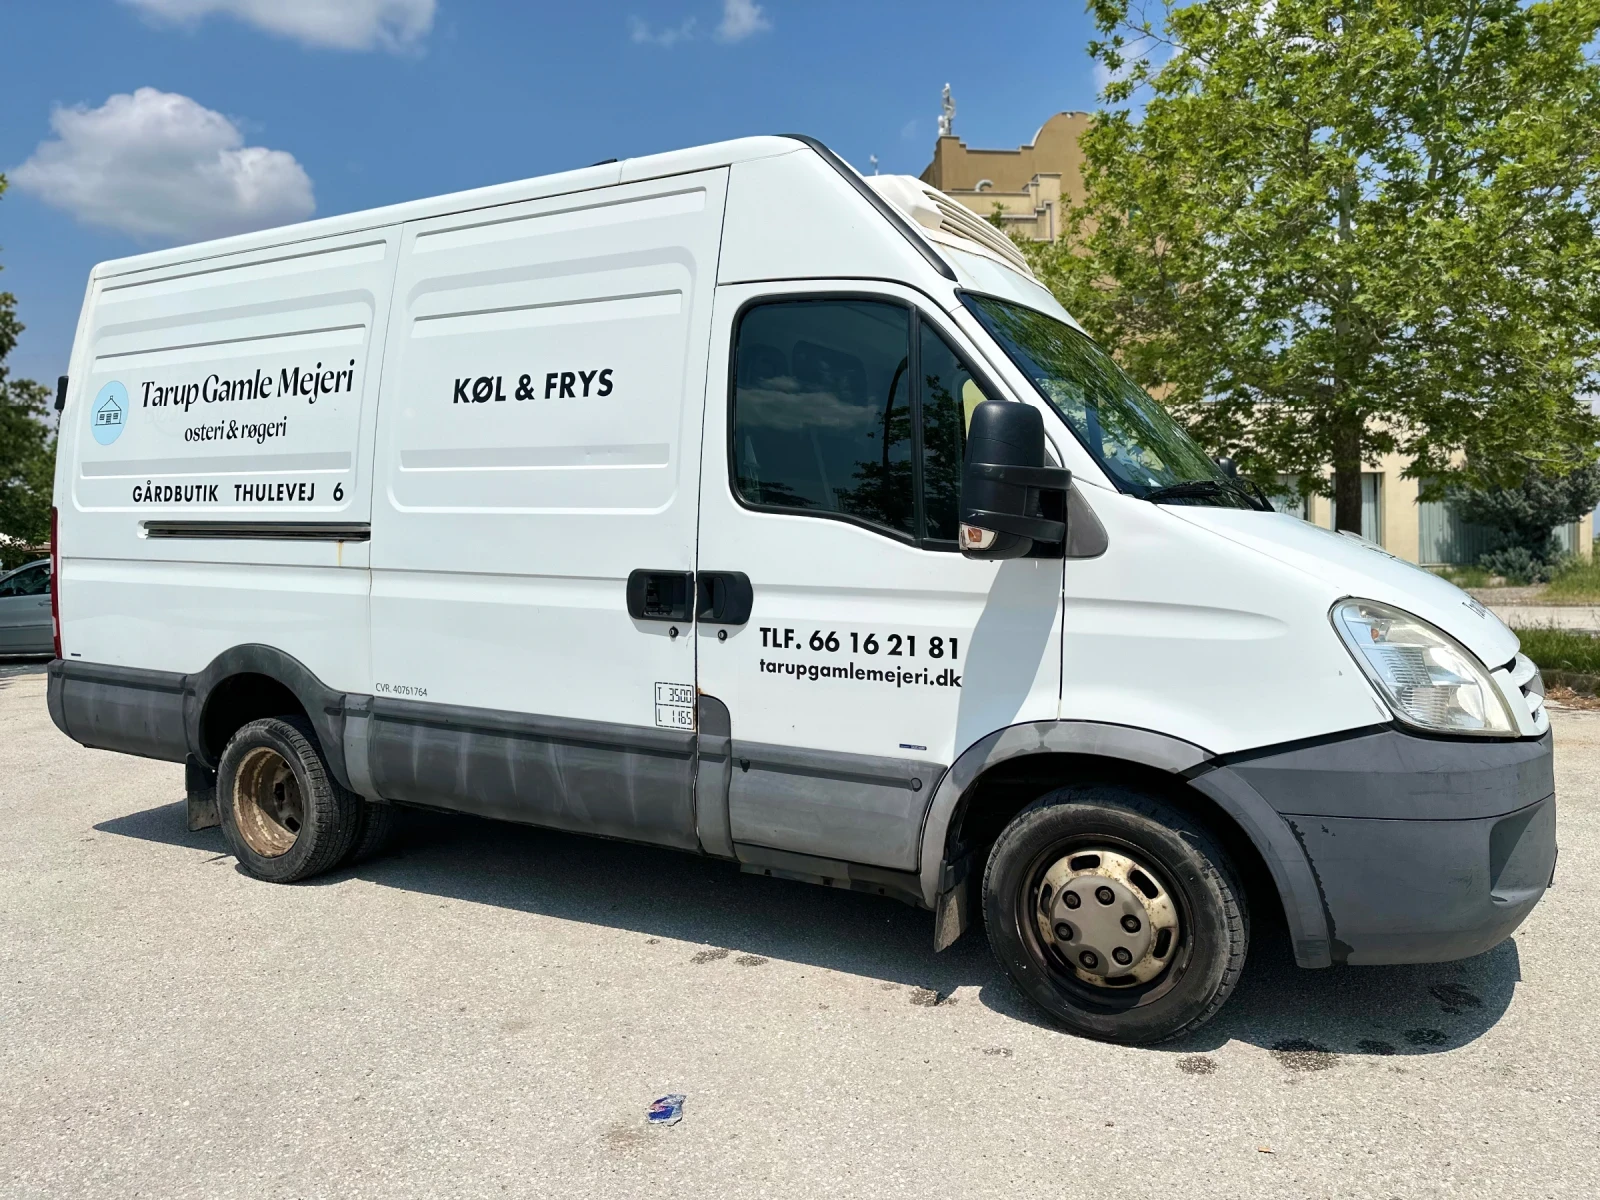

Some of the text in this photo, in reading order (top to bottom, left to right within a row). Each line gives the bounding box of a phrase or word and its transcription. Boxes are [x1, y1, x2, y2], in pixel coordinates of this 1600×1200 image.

[141, 359, 355, 412] Tarup Gamle Mejeri
[453, 368, 614, 404] KØL & FRYS
[184, 416, 287, 444] osteri & røgeri
[132, 480, 344, 502] GÅRDBUTIK THULEVEJ 6
[759, 627, 958, 659] TLF. 66 16 21 81
[759, 658, 962, 688] tarupgamlemejeri.dk
[393, 685, 427, 697] 40761764
[657, 686, 692, 703] T 3500
[658, 709, 662, 722] L
